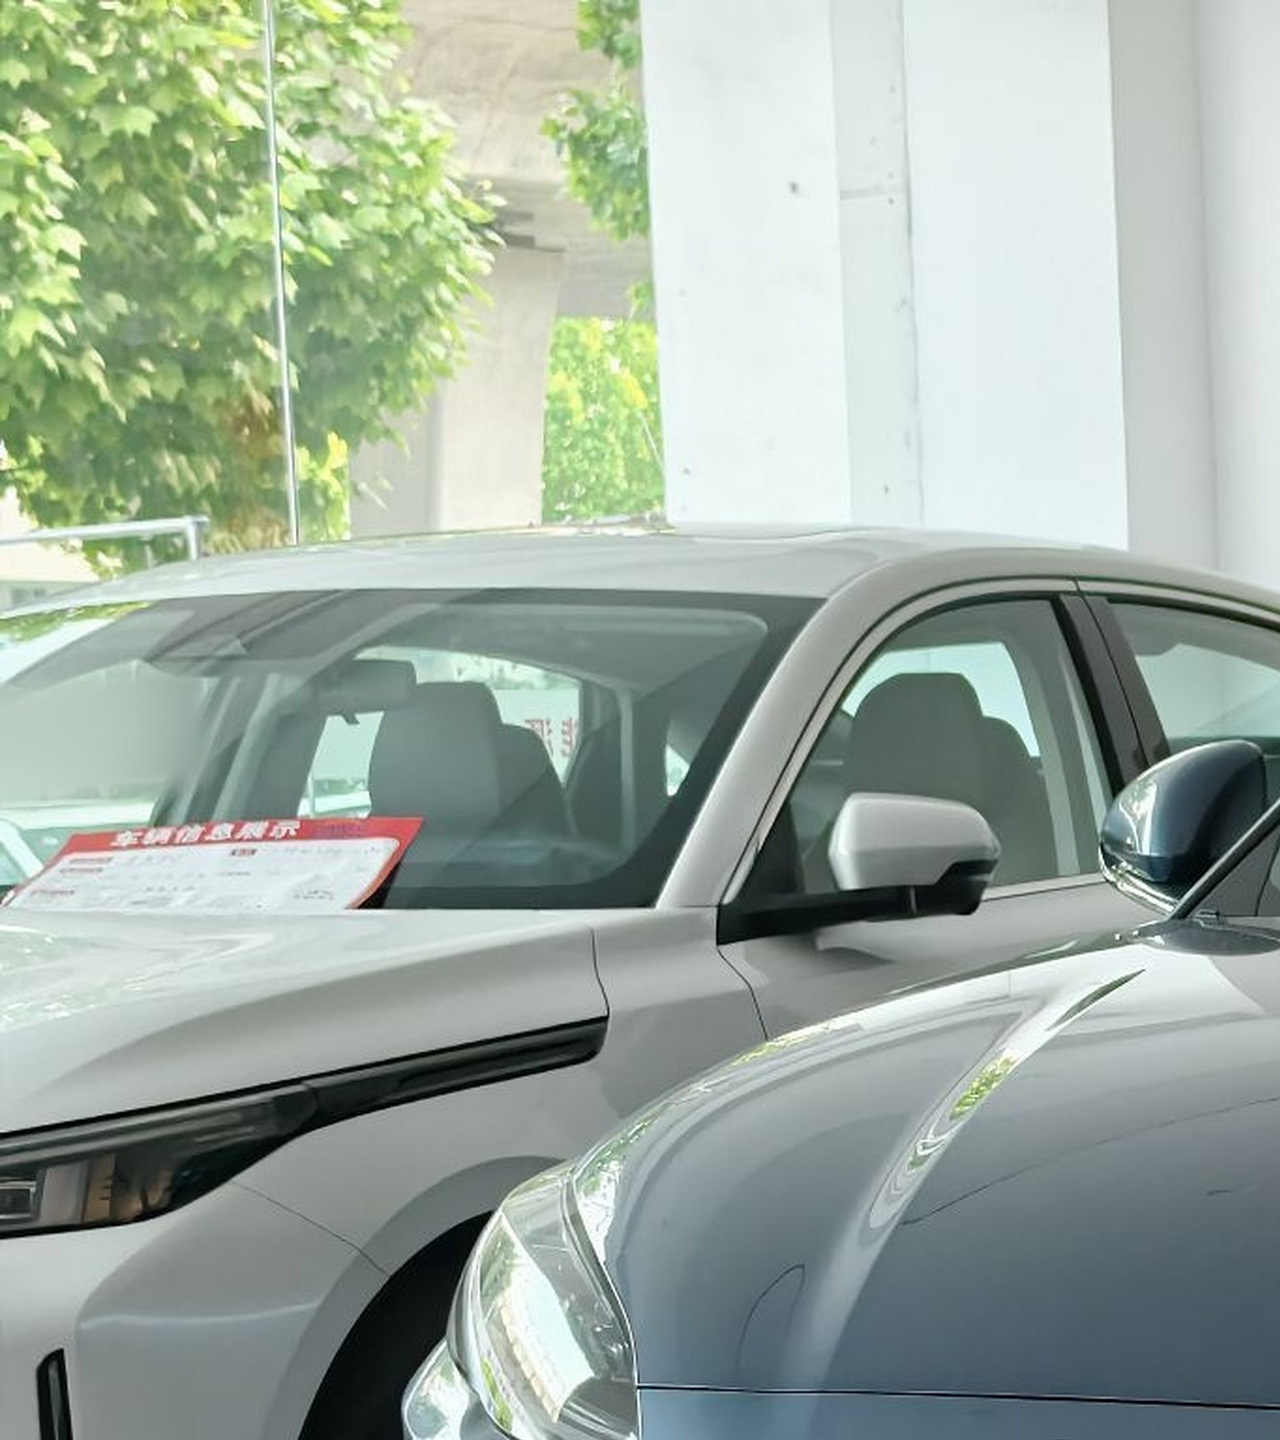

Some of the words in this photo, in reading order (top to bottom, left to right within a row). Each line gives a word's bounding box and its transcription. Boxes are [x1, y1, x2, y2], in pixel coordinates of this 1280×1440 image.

[110, 820, 301, 847] 车辆信息展示
